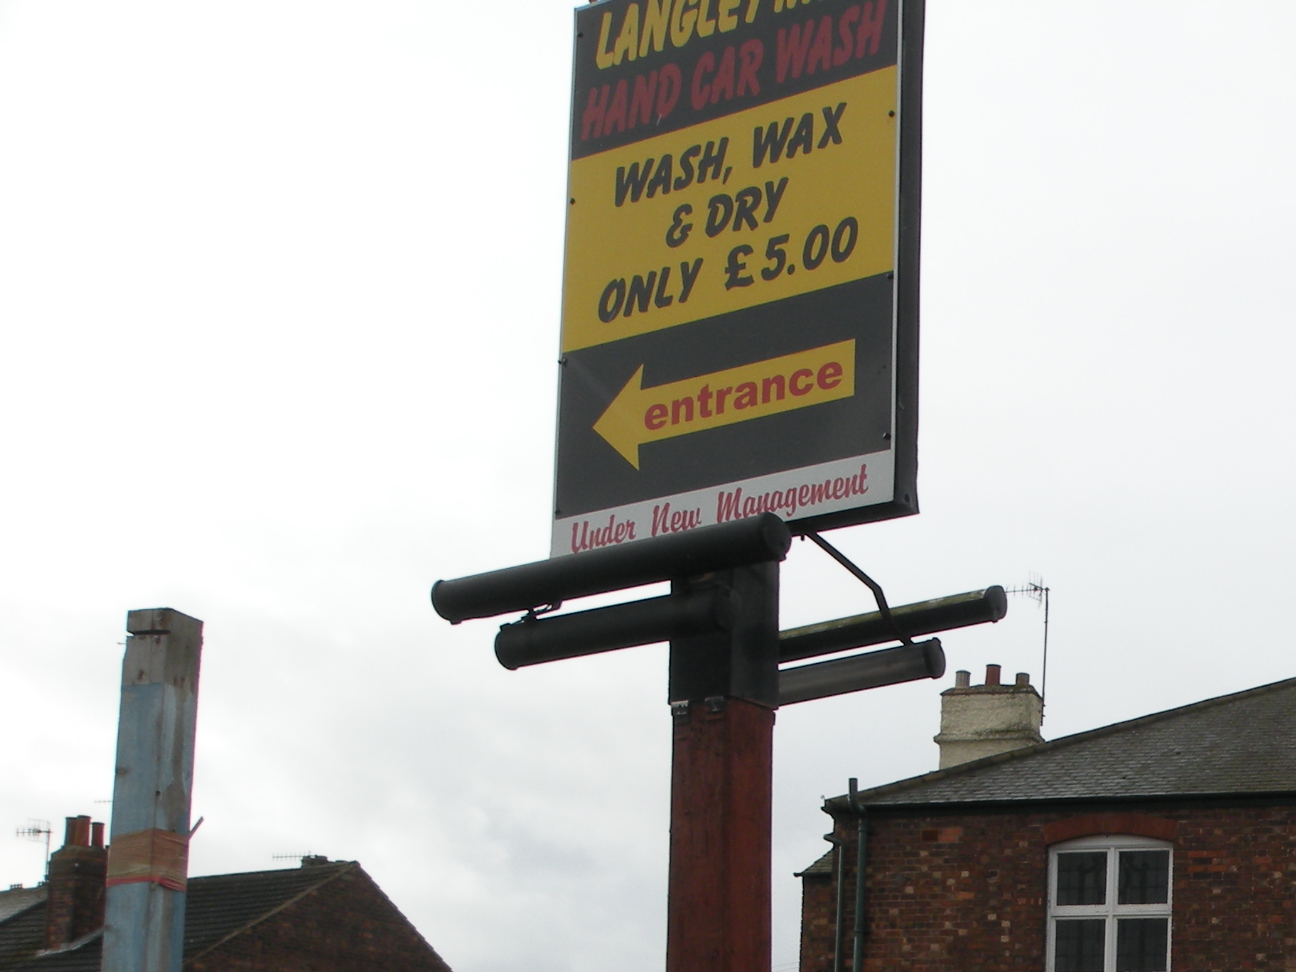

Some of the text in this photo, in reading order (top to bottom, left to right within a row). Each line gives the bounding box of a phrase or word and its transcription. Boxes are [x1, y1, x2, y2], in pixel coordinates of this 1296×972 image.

[581, 0, 888, 141] HAND CAR WASH
[614, 102, 848, 208] WASH, WAX
[665, 177, 790, 248] & DRY
[598, 216, 859, 323] ONLY £5.00
[644, 361, 844, 431] entrance
[571, 463, 869, 554] Under New Management
